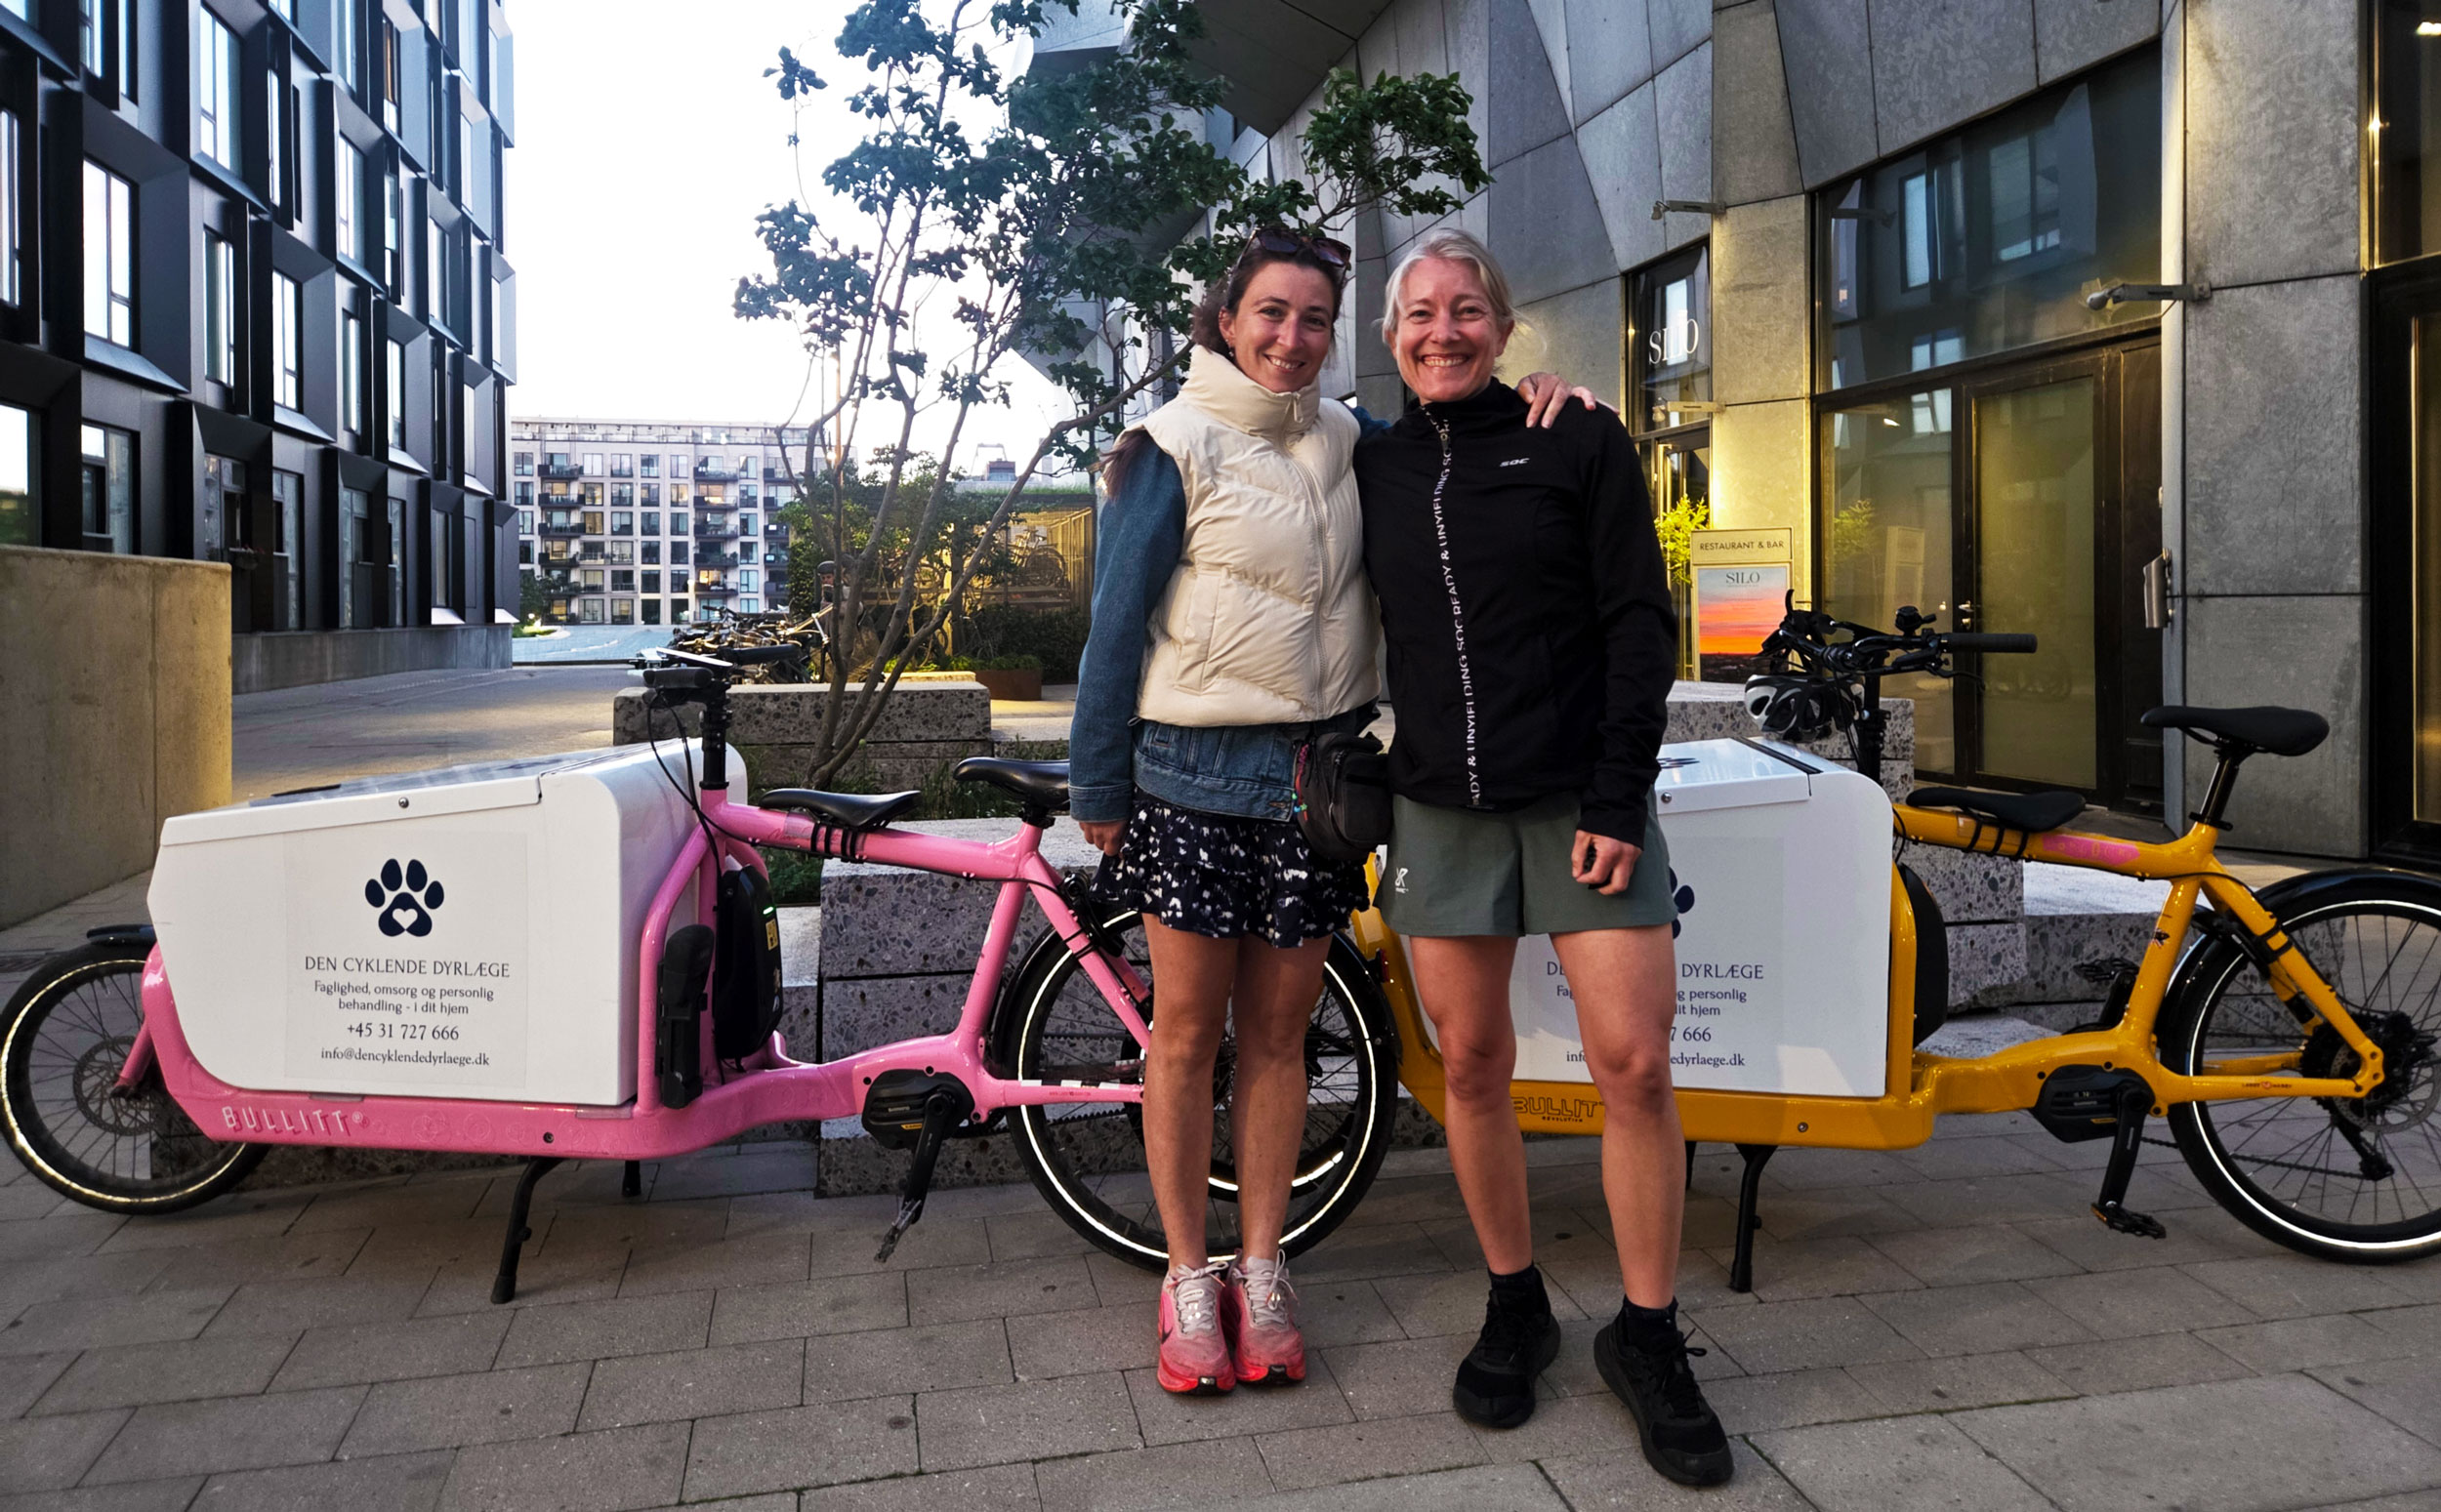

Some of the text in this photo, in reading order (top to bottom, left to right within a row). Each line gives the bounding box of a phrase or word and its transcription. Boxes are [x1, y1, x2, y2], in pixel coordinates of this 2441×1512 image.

[1648, 318, 1699, 365] SILO
[1699, 541, 1755, 552] RESTAURANT
[1766, 540, 1785, 550] BAR
[1725, 571, 1760, 585] SILO
[305, 956, 511, 978] DEN CYKLENDE DYRLÆGE
[1681, 962, 1764, 980] DYRLÆGE
[313, 979, 494, 1002] Faglighed, omsorg og personlig
[1689, 988, 1748, 1002] personlig
[338, 998, 403, 1015] behandling
[421, 1001, 436, 1014] dit
[439, 1002, 470, 1017] hjem
[1690, 1003, 1721, 1018] hjem
[347, 1022, 460, 1042] +45 31 727 666
[1682, 1026, 1713, 1042] 666
[320, 1046, 490, 1068] info@dencyklendedyrlaege.dk
[1510, 1095, 1604, 1119] BULLIT
